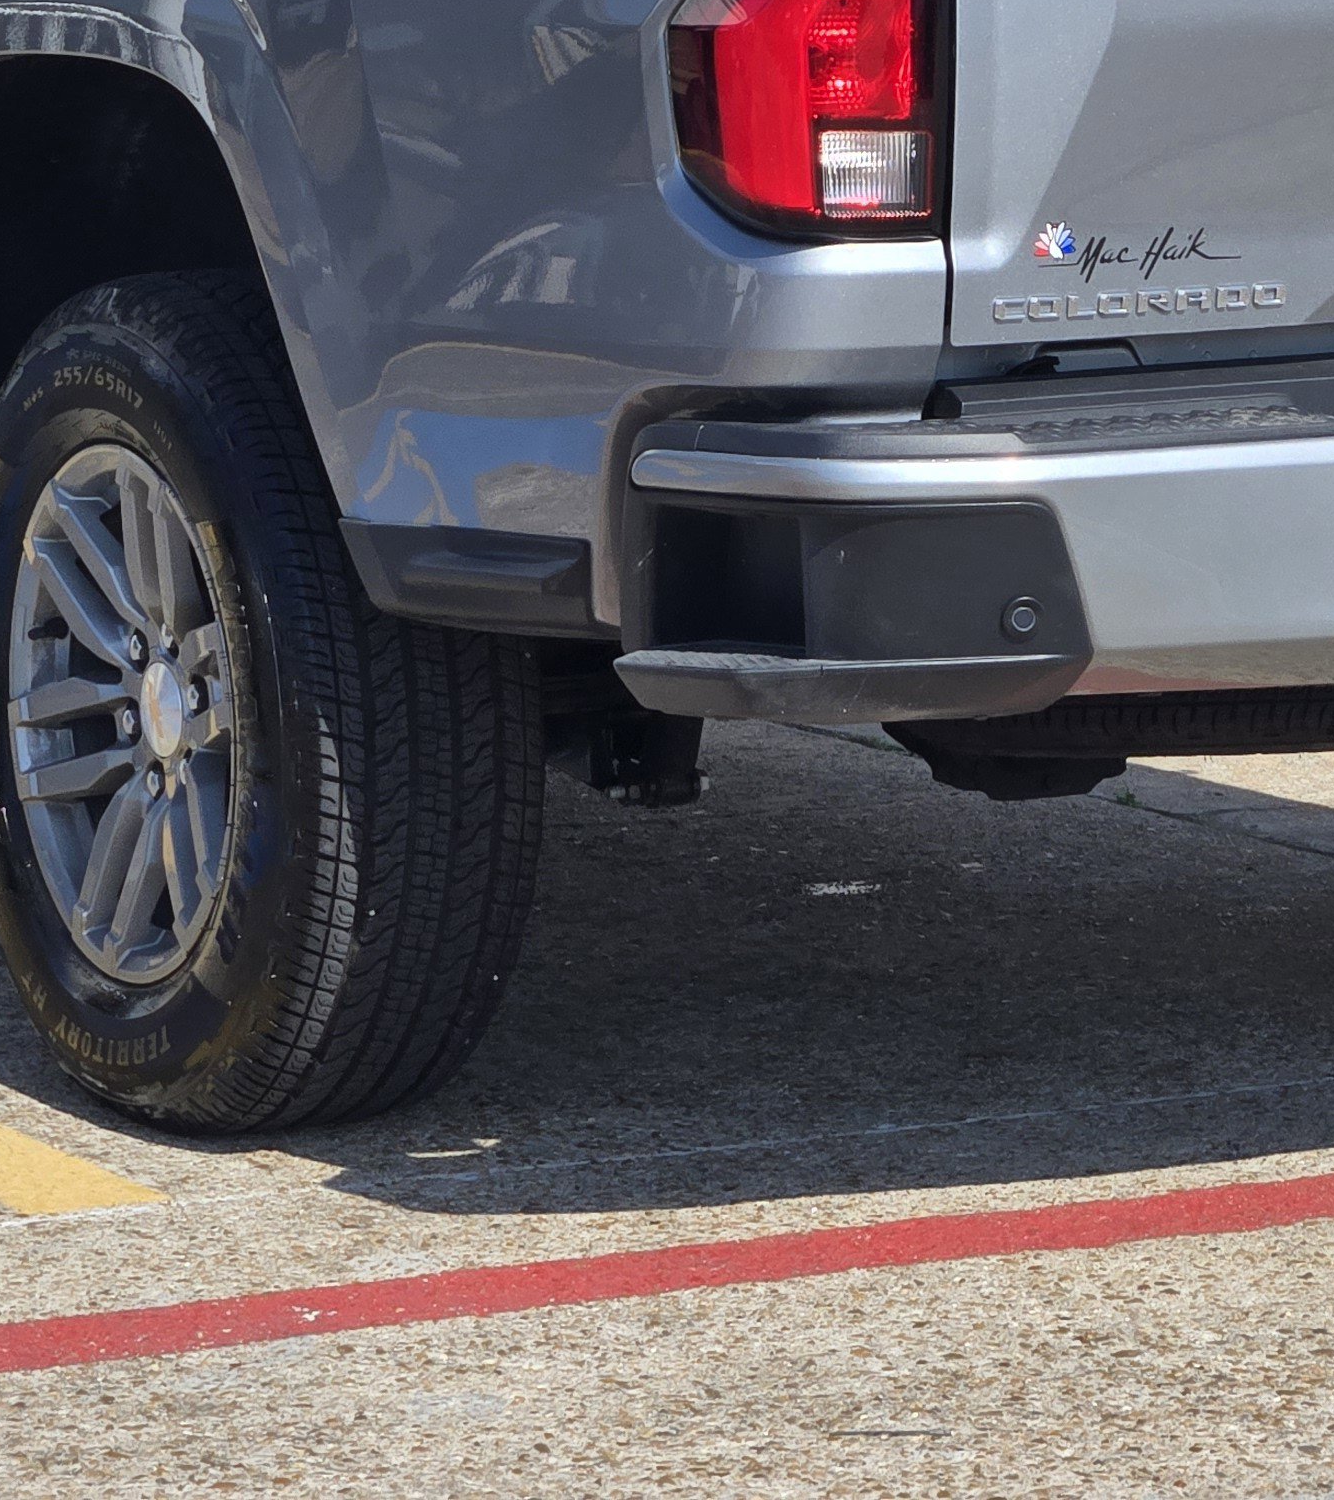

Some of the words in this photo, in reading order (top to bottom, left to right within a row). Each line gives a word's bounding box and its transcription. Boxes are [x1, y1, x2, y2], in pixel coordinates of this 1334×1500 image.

[1062, 236, 1139, 283] Mac
[1139, 227, 1229, 280] Haik
[993, 281, 1286, 322] COLORADO
[53, 364, 144, 409] 255/65R17
[54, 1014, 172, 1067] TERRITORY
